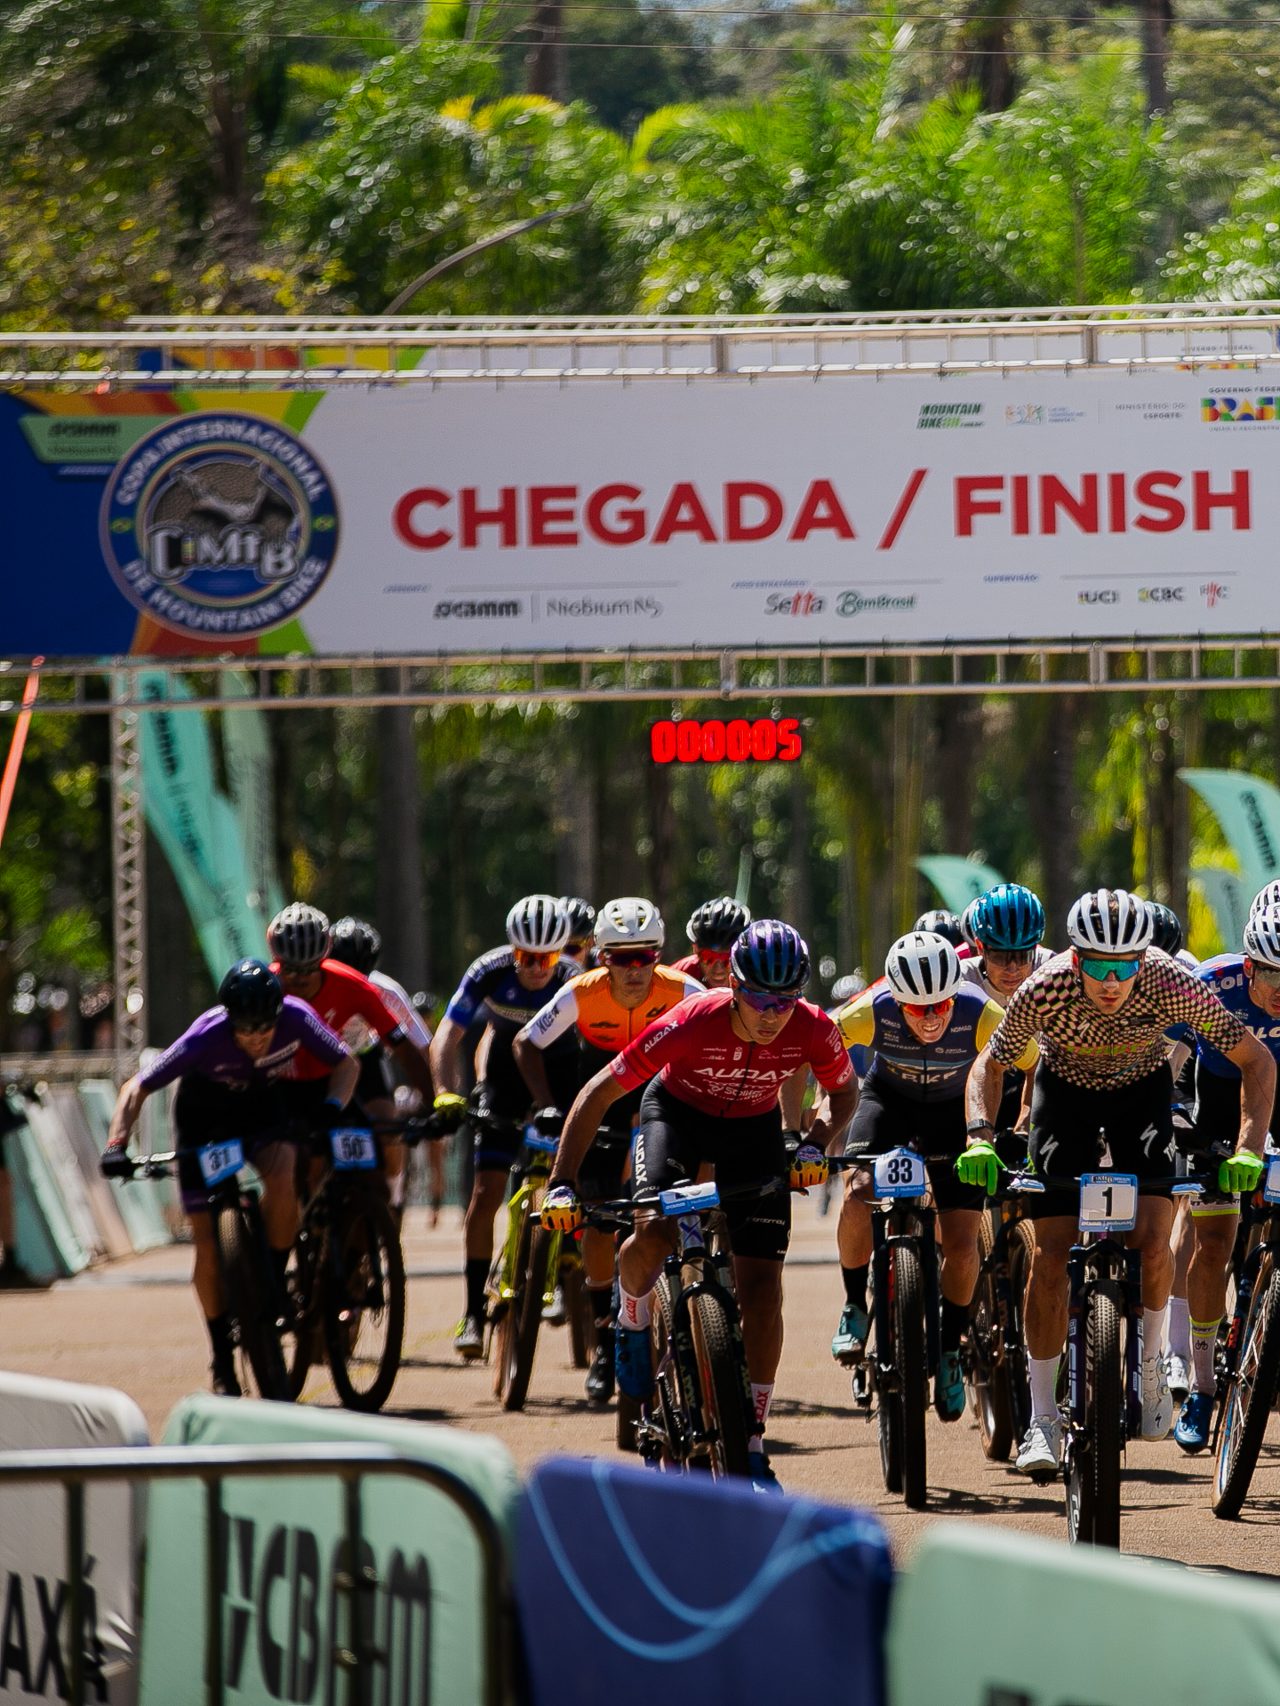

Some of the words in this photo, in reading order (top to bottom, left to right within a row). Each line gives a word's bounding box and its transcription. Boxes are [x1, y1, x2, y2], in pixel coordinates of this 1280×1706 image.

[919, 402, 982, 416] MOUNTAIN
[392, 477, 858, 552] CHEGADA
[874, 469, 928, 550] /
[954, 469, 1253, 537] FINISH
[644, 1019, 679, 1053] AUDAX
[950, 1025, 973, 1033] NOMAD
[693, 1067, 797, 1081] AUDAX
[635, 1134, 648, 1186] AUDAX
[887, 1156, 913, 1184] 33
[1102, 1187, 1113, 1217] 1
